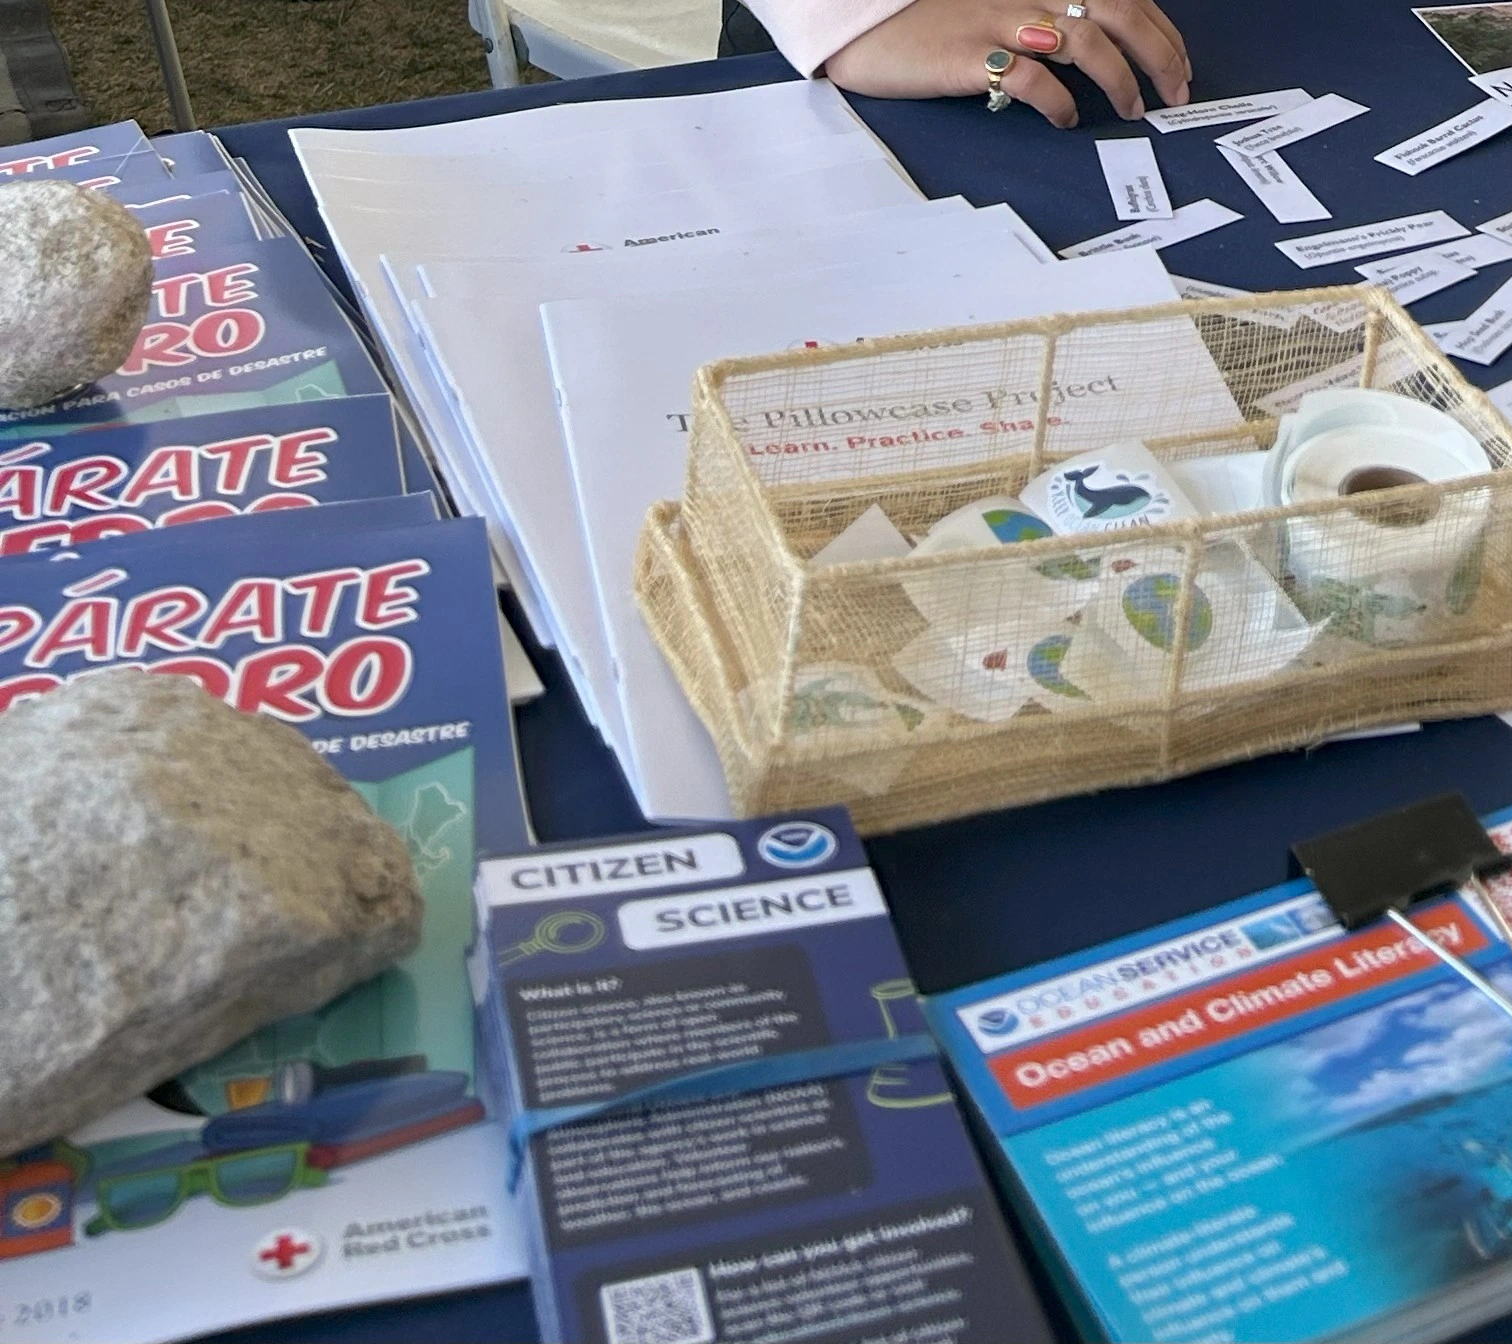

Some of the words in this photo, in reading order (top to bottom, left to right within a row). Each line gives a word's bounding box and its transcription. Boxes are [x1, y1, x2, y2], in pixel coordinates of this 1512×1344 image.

[1455, 114, 1485, 133] Cactus
[622, 226, 721, 248] American
[1407, 219, 1435, 230] Pear
[64, 390, 121, 411] PARA
[127, 376, 192, 398] CASOS
[197, 368, 223, 383] DE
[228, 345, 327, 377] DESASTRE
[666, 411, 750, 432] Te
[764, 396, 974, 430] Pillowcase
[749, 441, 839, 457] Learn.
[847, 427, 970, 450] Practice.
[979, 414, 1071, 435] Shae.
[350, 721, 470, 753] DESASTRE
[511, 847, 700, 893] CITIZEN
[656, 882, 855, 935] SCIENCE
[519, 984, 572, 1002] What
[576, 981, 593, 995] is
[1015, 1036, 1135, 1088] Ocean
[1137, 1008, 1205, 1048] and
[1206, 968, 1333, 1023] Climate
[1056, 1133, 1181, 1183] understanding
[343, 1204, 488, 1241] American
[343, 1234, 400, 1259] Red
[407, 1224, 492, 1250] Cross
[13, 1291, 93, 1327] 2018
